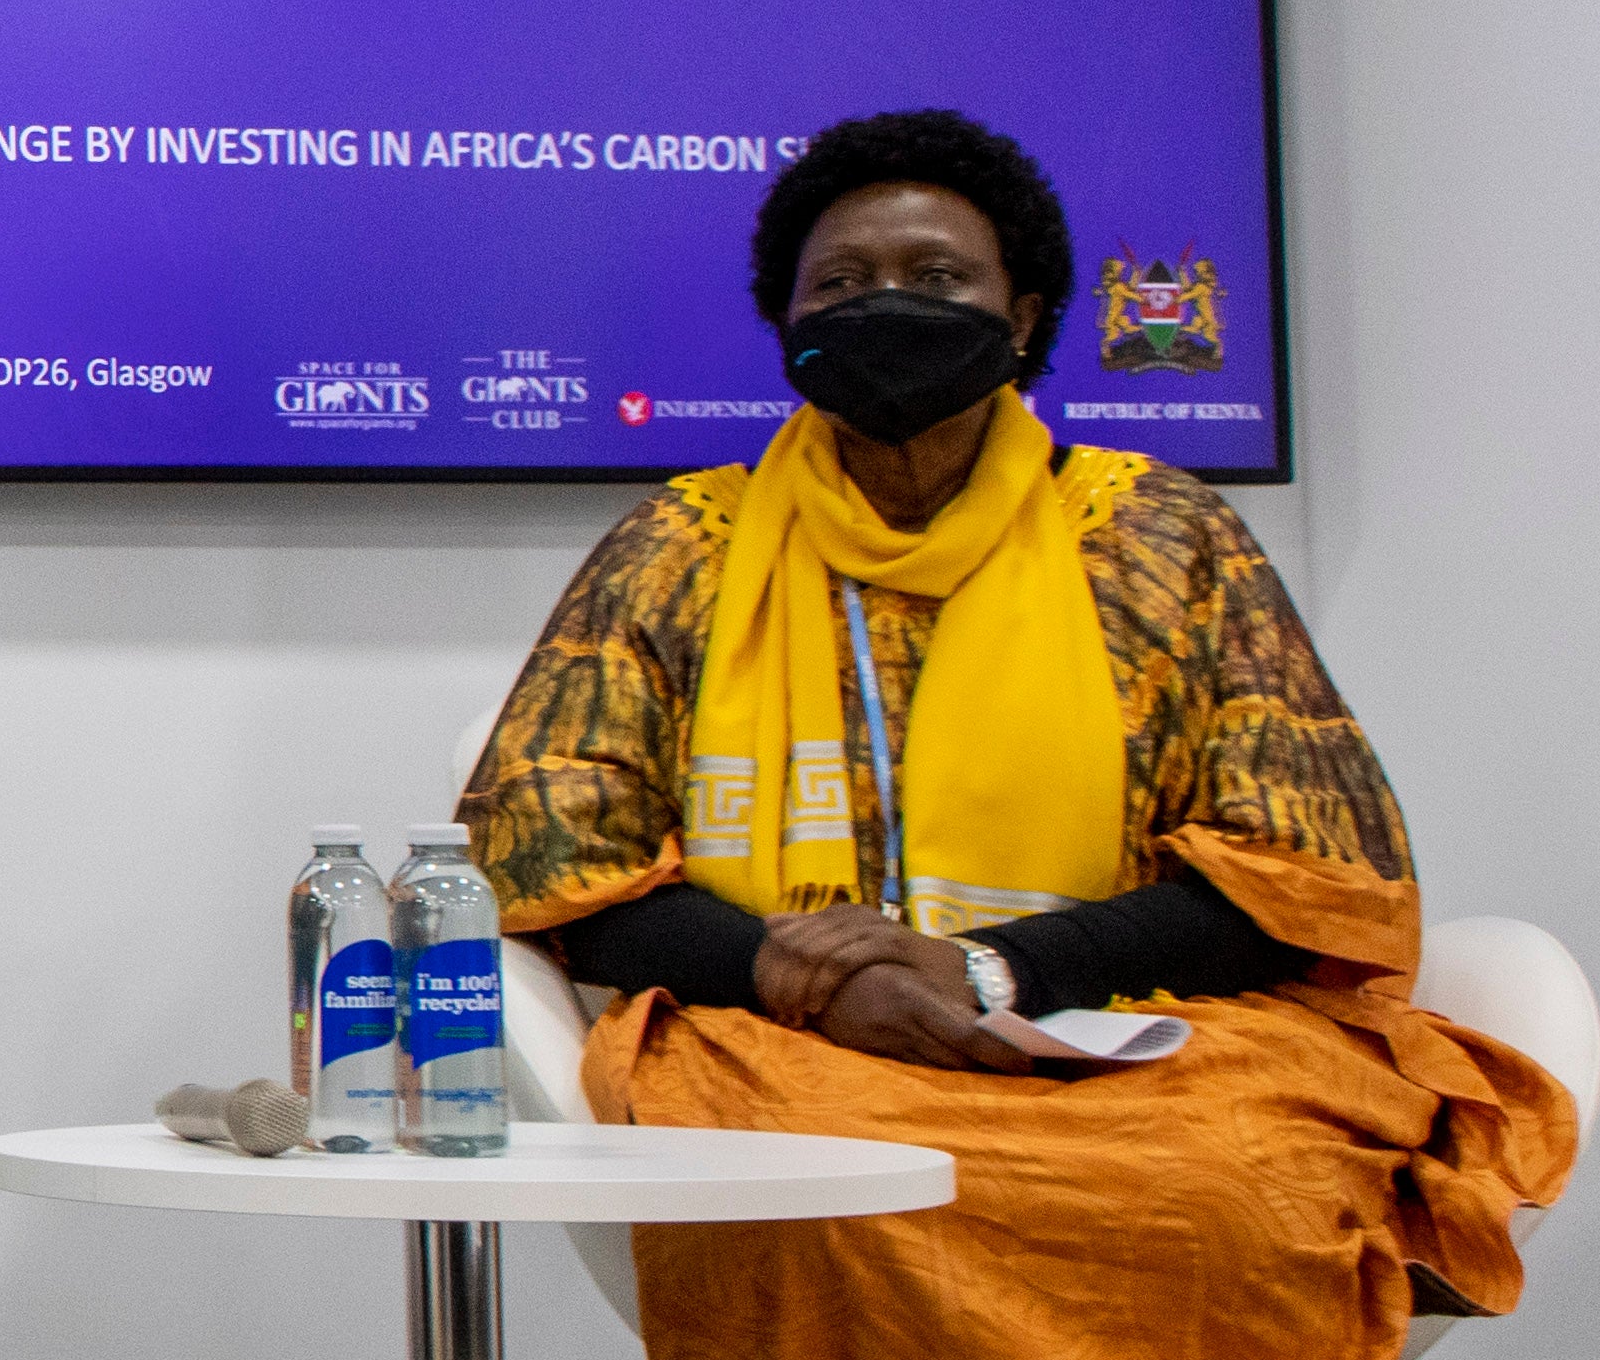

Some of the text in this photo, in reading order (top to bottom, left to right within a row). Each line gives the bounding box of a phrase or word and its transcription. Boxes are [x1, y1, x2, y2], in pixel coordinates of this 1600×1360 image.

[86, 124, 134, 164] BY
[146, 126, 358, 168] INVESTING
[370, 129, 411, 167] IN
[421, 131, 595, 170] AFRICA’S
[603, 133, 767, 172] CARBON
[299, 361, 401, 375] SPACE FOR
[501, 350, 552, 370] THE
[87, 357, 213, 393] Glasgow
[492, 410, 563, 430] CLUB
